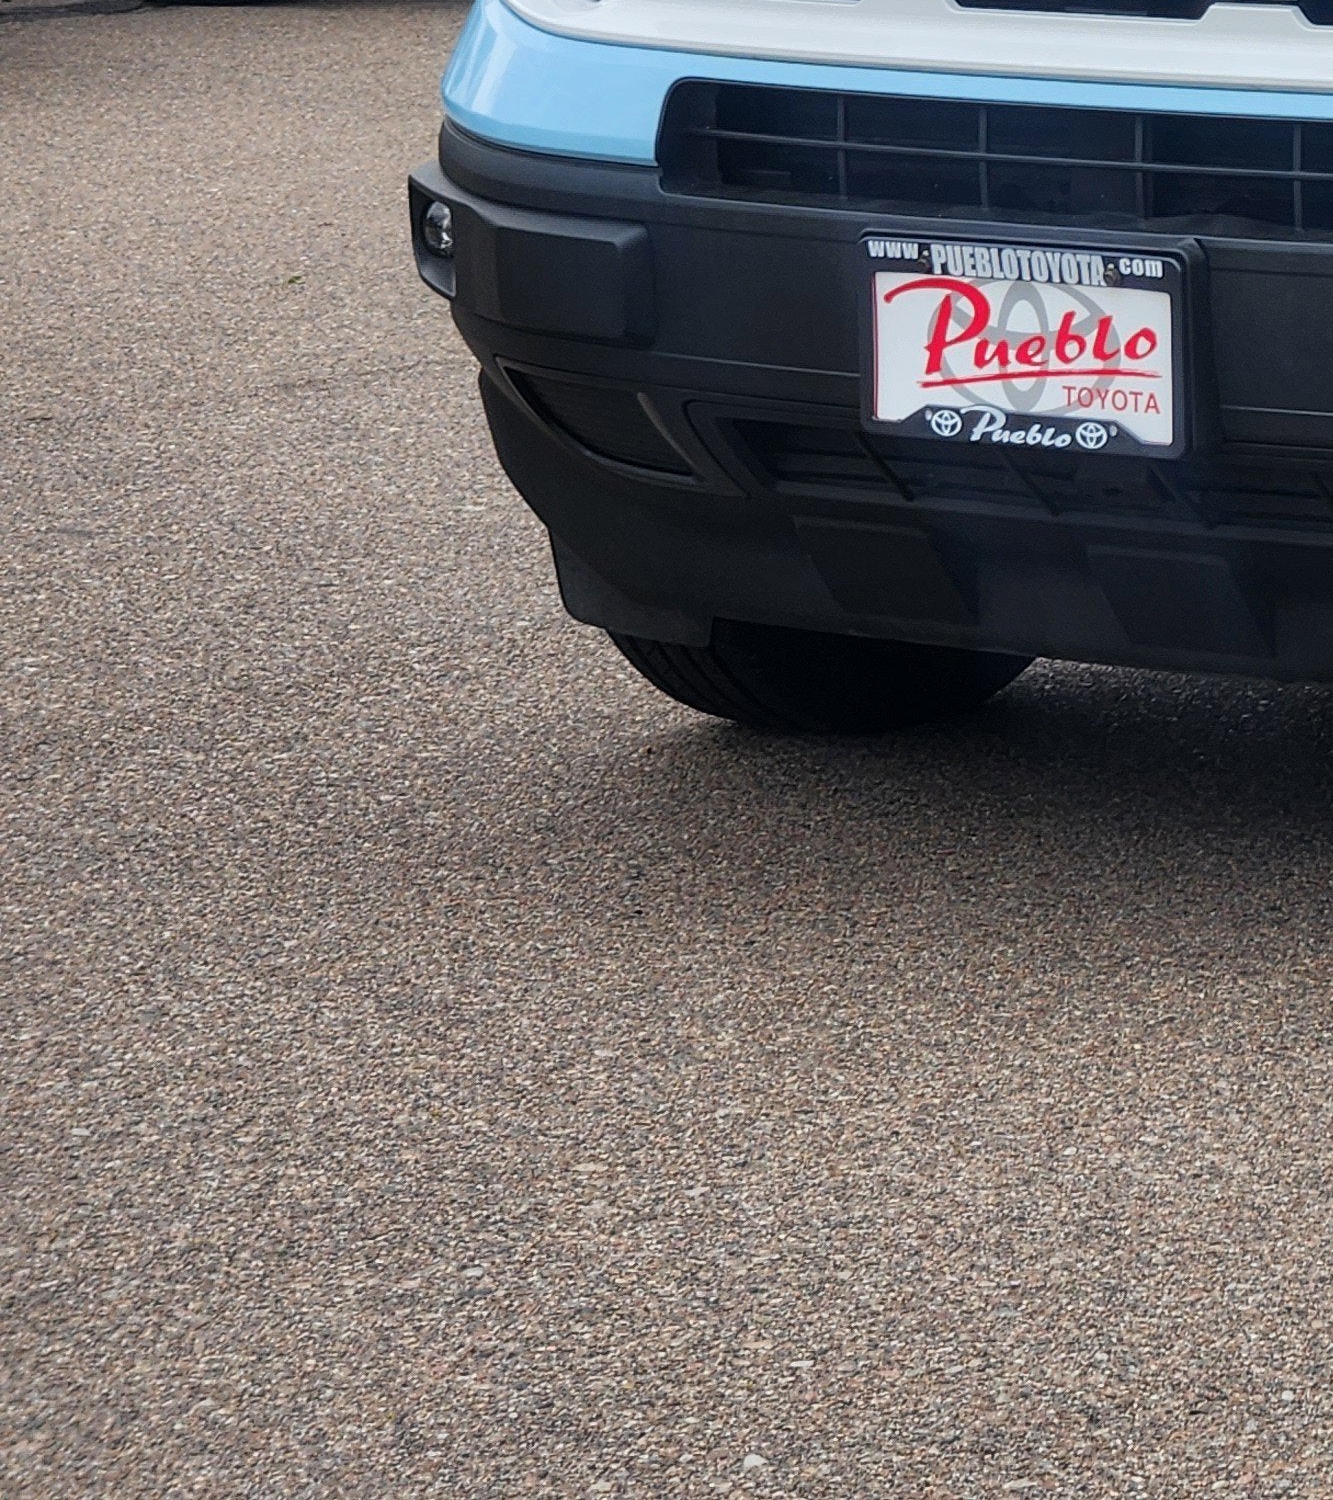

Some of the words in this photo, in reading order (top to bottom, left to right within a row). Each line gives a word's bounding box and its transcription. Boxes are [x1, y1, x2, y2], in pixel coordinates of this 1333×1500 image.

[883, 277, 1158, 375] Pueblo
[1062, 385, 1162, 415] TOYOTA
[960, 404, 1073, 448] Pueblo
